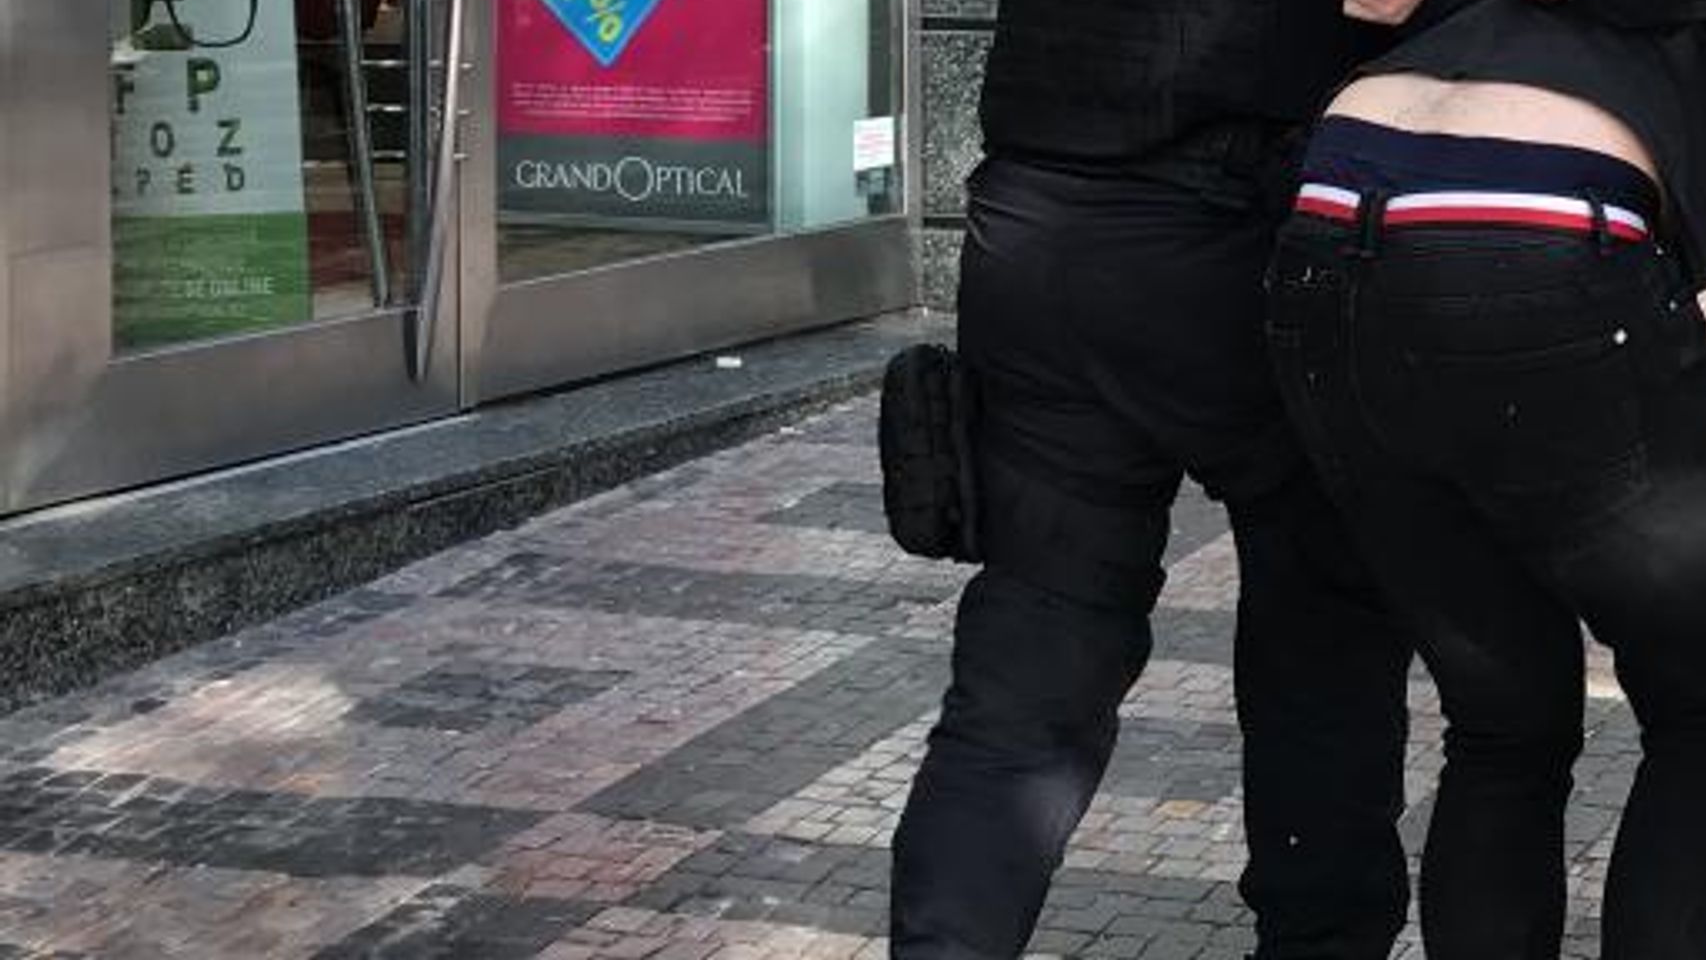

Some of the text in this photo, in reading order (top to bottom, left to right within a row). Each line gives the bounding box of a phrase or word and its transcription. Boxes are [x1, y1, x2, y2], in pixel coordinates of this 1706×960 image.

[186, 57, 221, 113] P
[216, 117, 243, 157] Z
[516, 156, 748, 201] GRANDOPTICAL
